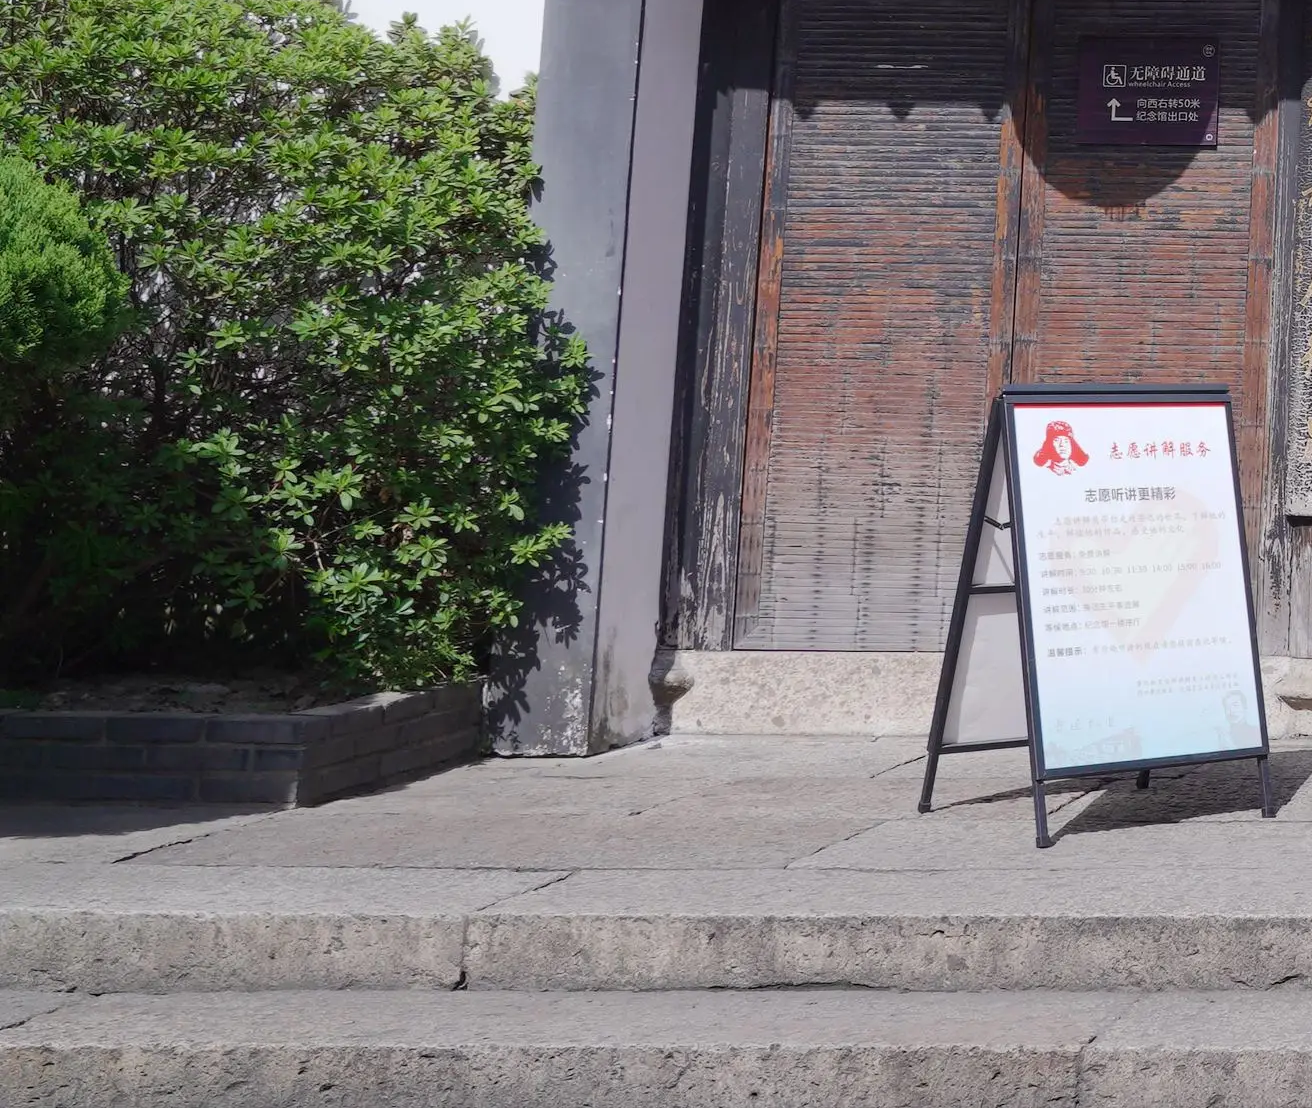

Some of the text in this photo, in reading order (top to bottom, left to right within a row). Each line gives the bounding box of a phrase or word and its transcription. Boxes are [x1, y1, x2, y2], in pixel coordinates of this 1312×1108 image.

[1129, 66, 1206, 82] 无障碍通道
[1136, 98, 1200, 109] 向西右转50米
[1136, 111, 1199, 122] 纪念馆出口处
[1109, 441, 1212, 460] 志愿讲解服务
[1084, 486, 1176, 503] 志愿听讲更精彩
